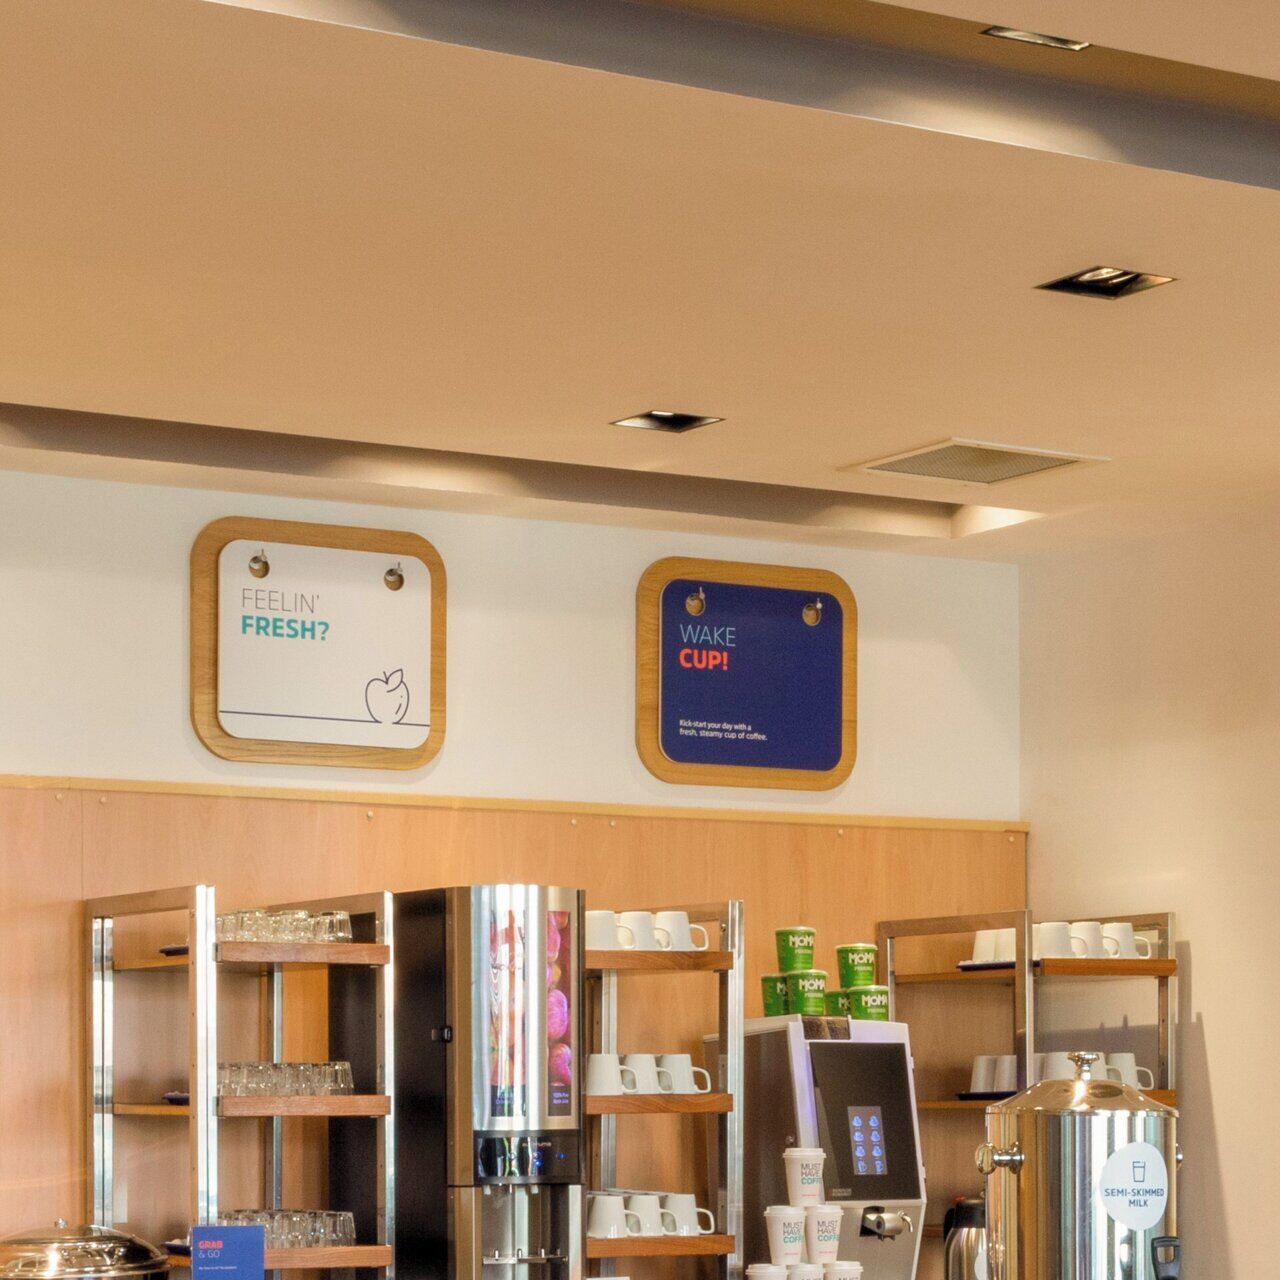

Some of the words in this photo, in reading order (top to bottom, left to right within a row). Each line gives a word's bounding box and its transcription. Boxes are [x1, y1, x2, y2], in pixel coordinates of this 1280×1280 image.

[242, 587, 320, 613] FEELIN'
[241, 614, 330, 641] FRESH?
[679, 624, 736, 647] WAKE
[679, 648, 729, 671] CUP!
[722, 722, 733, 731] day
[699, 729, 723, 738] steamy
[746, 733, 768, 741] coffee.
[1104, 1188, 1165, 1197] SEMI-SKIMMED
[1128, 1199, 1149, 1207] MILK
[783, 1221, 803, 1229] MUST
[817, 1220, 838, 1228] MUST
[199, 1240, 223, 1249] GRAB
[199, 1250, 205, 1259] &
[208, 1250, 220, 1258] GO
